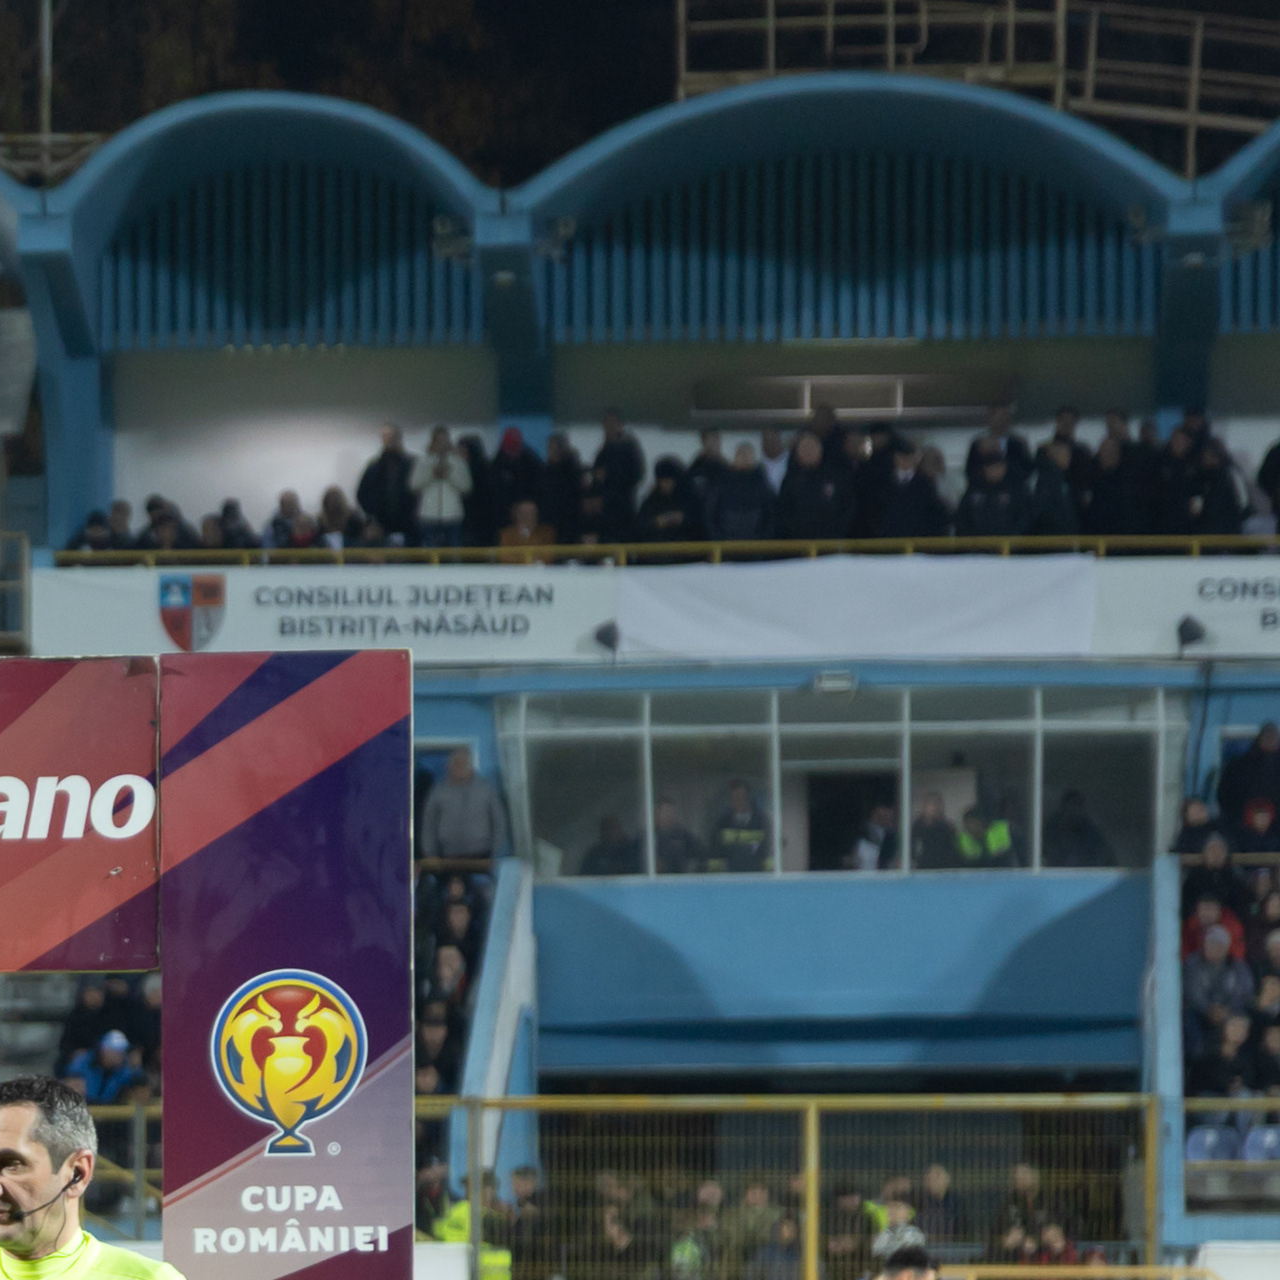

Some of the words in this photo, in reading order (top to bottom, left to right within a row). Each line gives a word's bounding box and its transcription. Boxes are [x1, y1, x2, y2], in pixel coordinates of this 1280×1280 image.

[253, 585, 399, 608] CONSILIUL
[1197, 576, 1280, 602] CONS
[241, 1184, 343, 1212] CUPA
[192, 1218, 389, 1255] ROMÂNIEI
